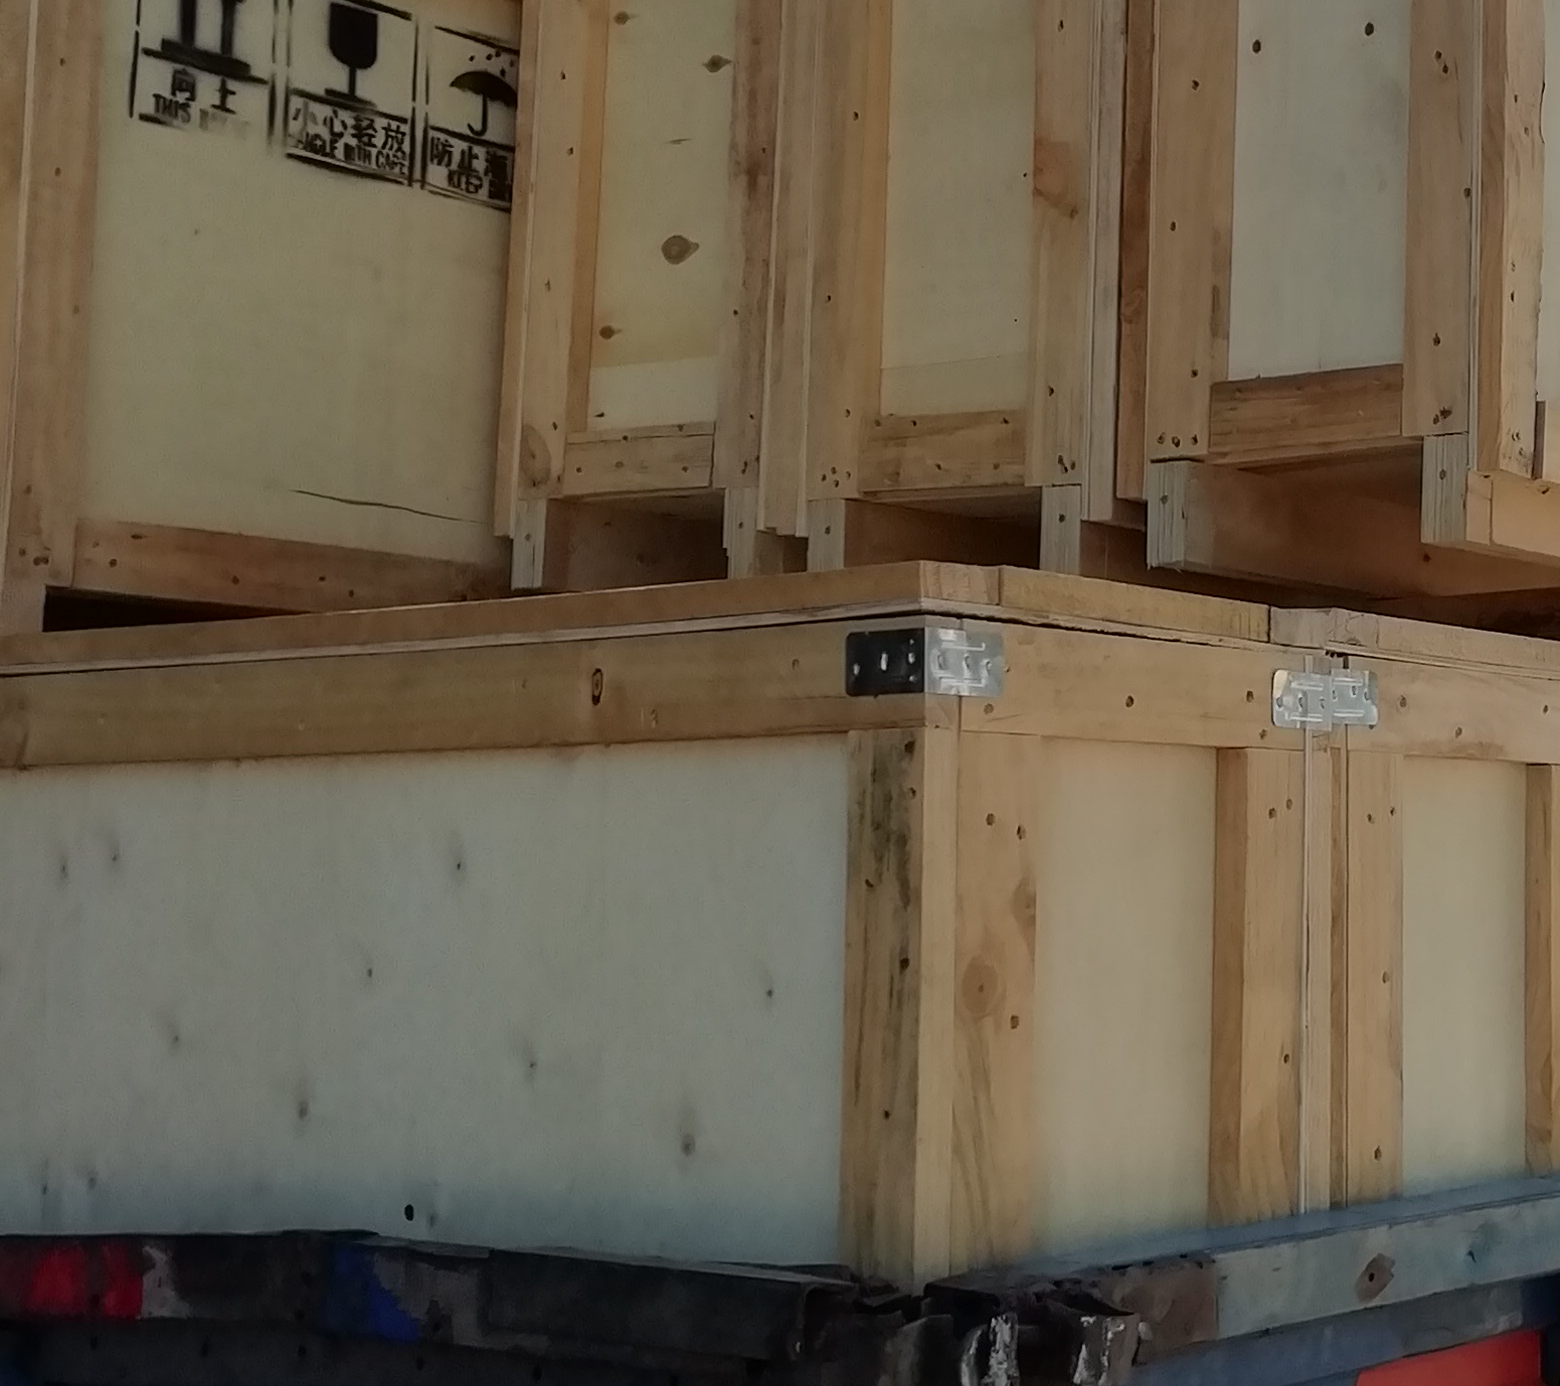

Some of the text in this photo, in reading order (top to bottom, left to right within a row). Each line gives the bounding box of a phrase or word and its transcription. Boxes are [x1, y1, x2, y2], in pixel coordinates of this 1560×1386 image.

[171, 67, 236, 114] 向上
[292, 100, 406, 153] 小心轻放
